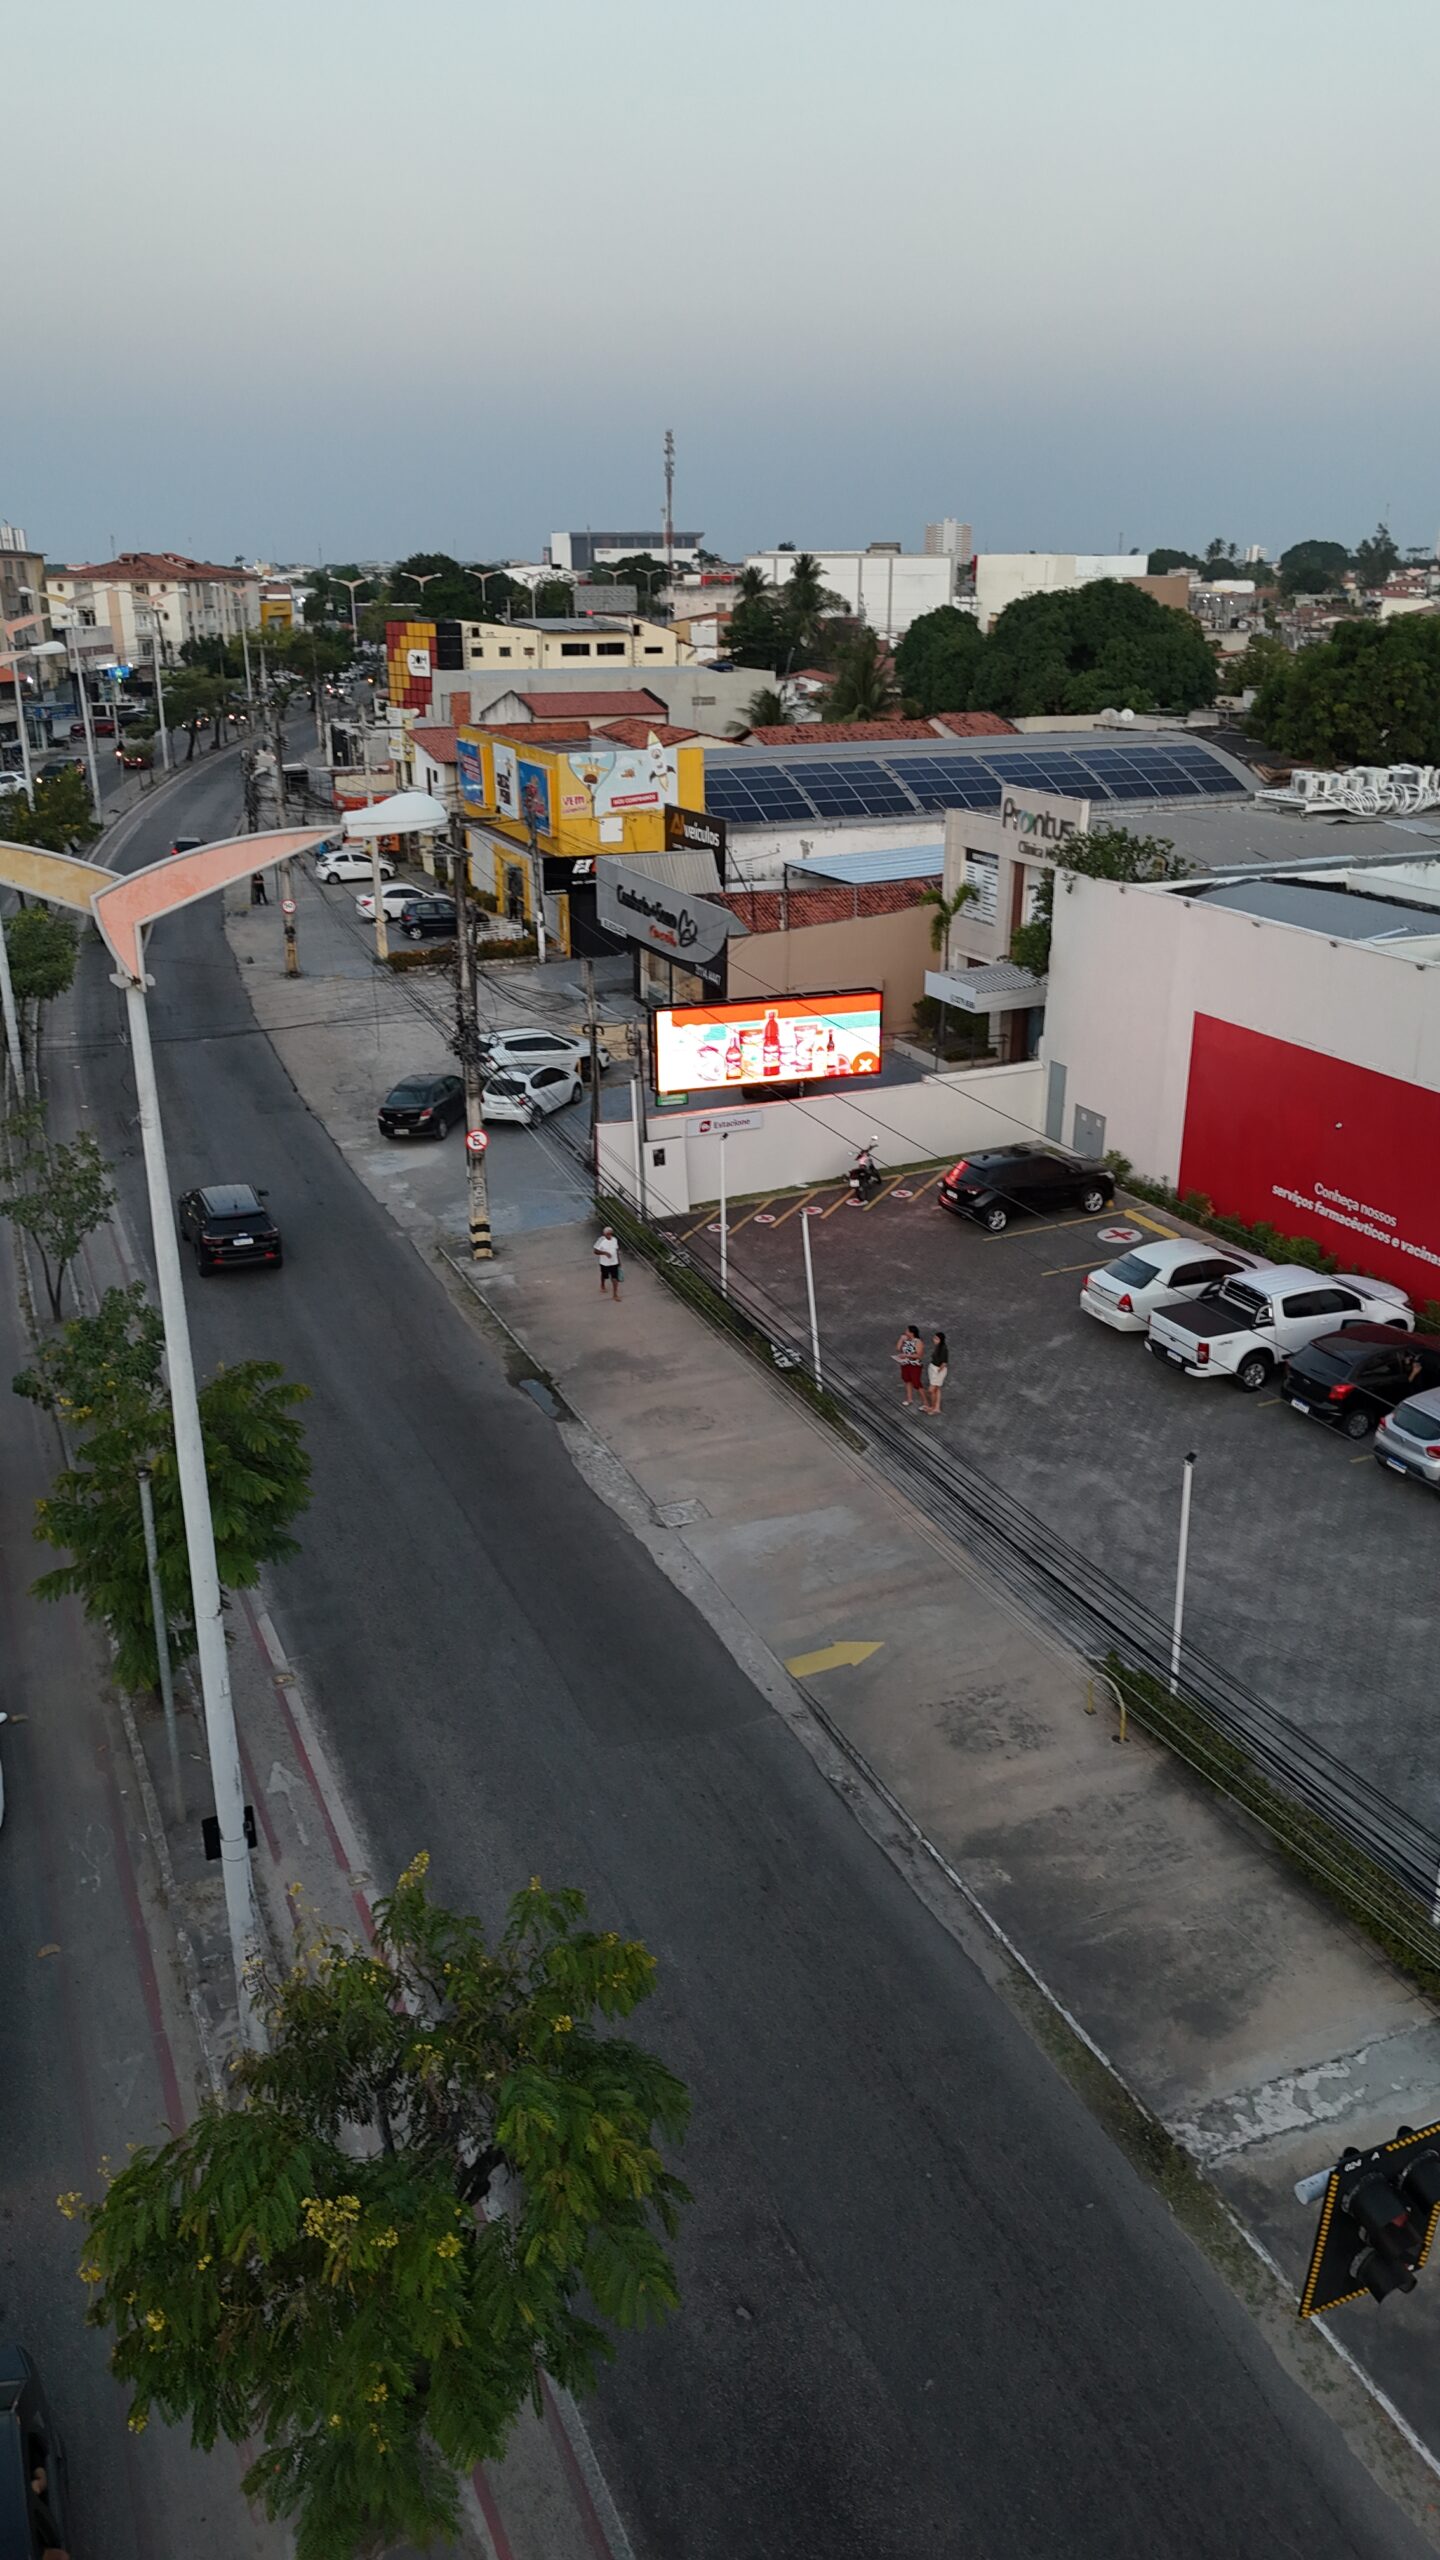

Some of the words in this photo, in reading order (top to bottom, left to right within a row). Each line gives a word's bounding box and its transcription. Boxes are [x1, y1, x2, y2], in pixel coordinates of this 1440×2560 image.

[1002, 797, 1075, 842] Prontus
[1271, 1184, 1314, 1208] serviços
[1313, 1201, 1391, 1244] farmacêuticos
[1391, 1237, 1400, 1247] e
[1314, 1182, 1360, 1211] Conheça
[1360, 1203, 1397, 1227] nossos
